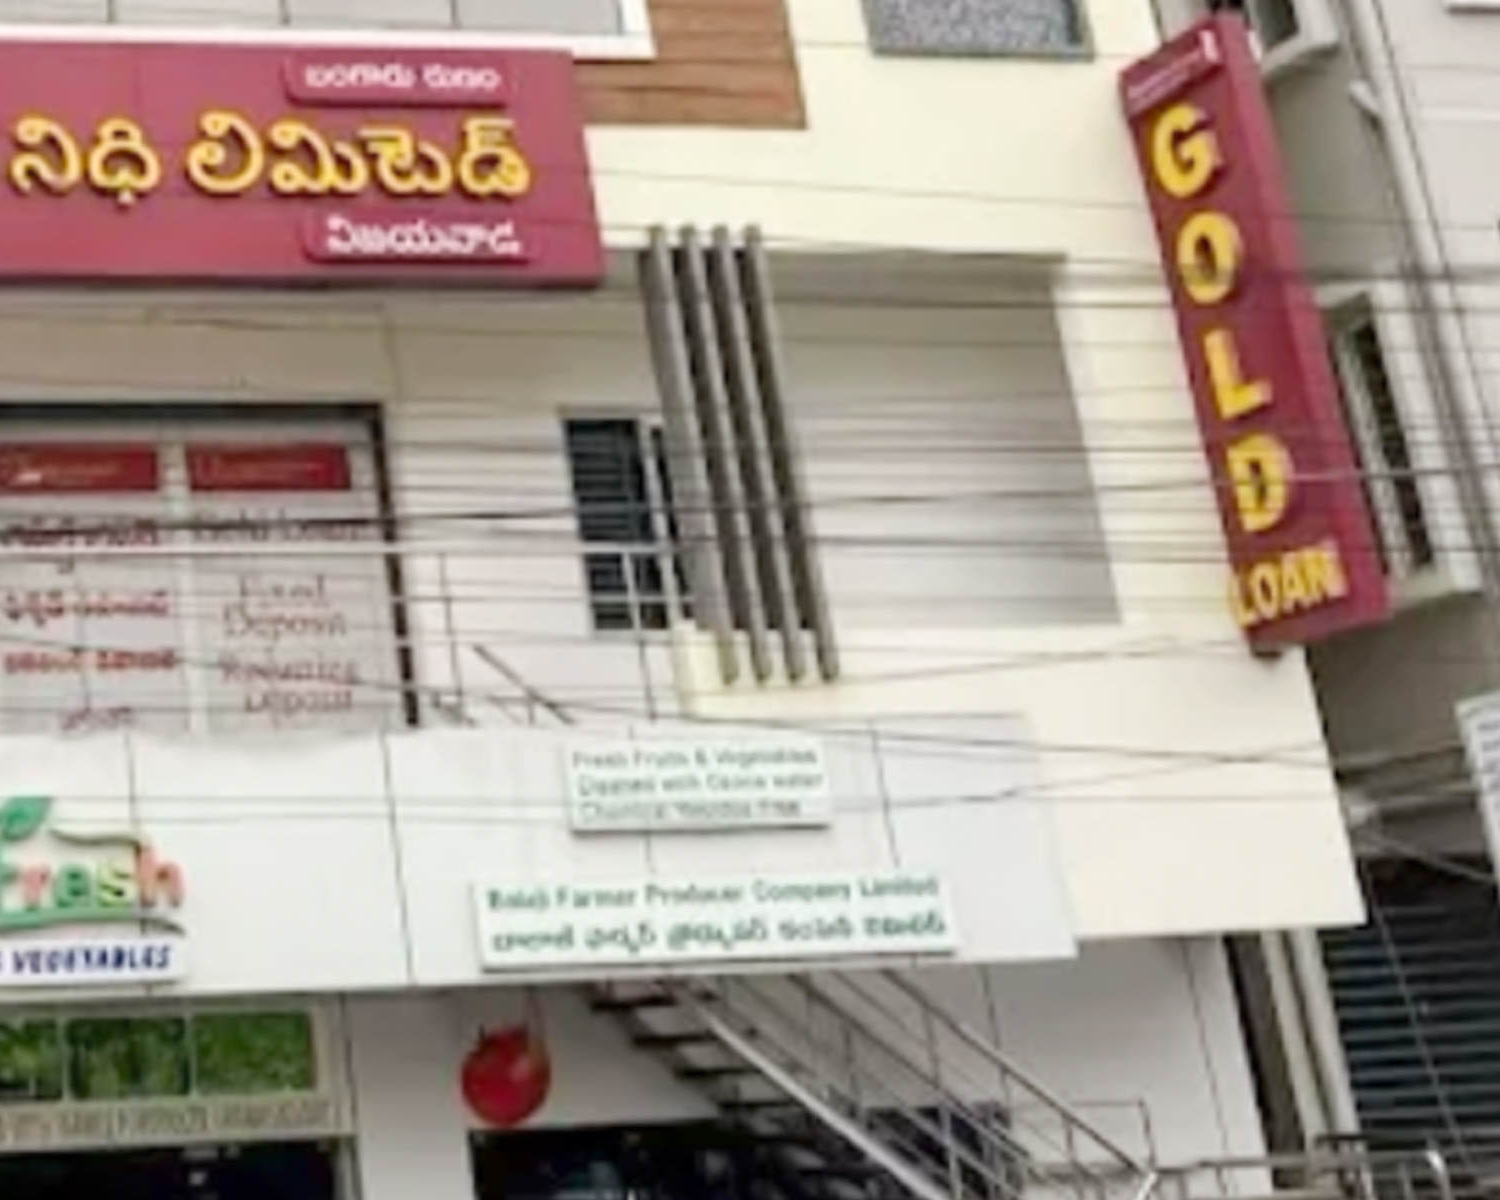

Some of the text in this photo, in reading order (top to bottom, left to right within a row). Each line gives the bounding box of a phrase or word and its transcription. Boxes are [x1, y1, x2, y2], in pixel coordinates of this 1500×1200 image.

[9, 115, 162, 209] నిధి
[186, 110, 531, 197] లిమిటెడ్
[325, 213, 522, 256] విజయవాడ
[1152, 104, 1293, 532] GOLD
[1231, 541, 1347, 628] LOAN
[751, 879, 852, 905] Company
[12, 944, 173, 975] VEGETABLES
